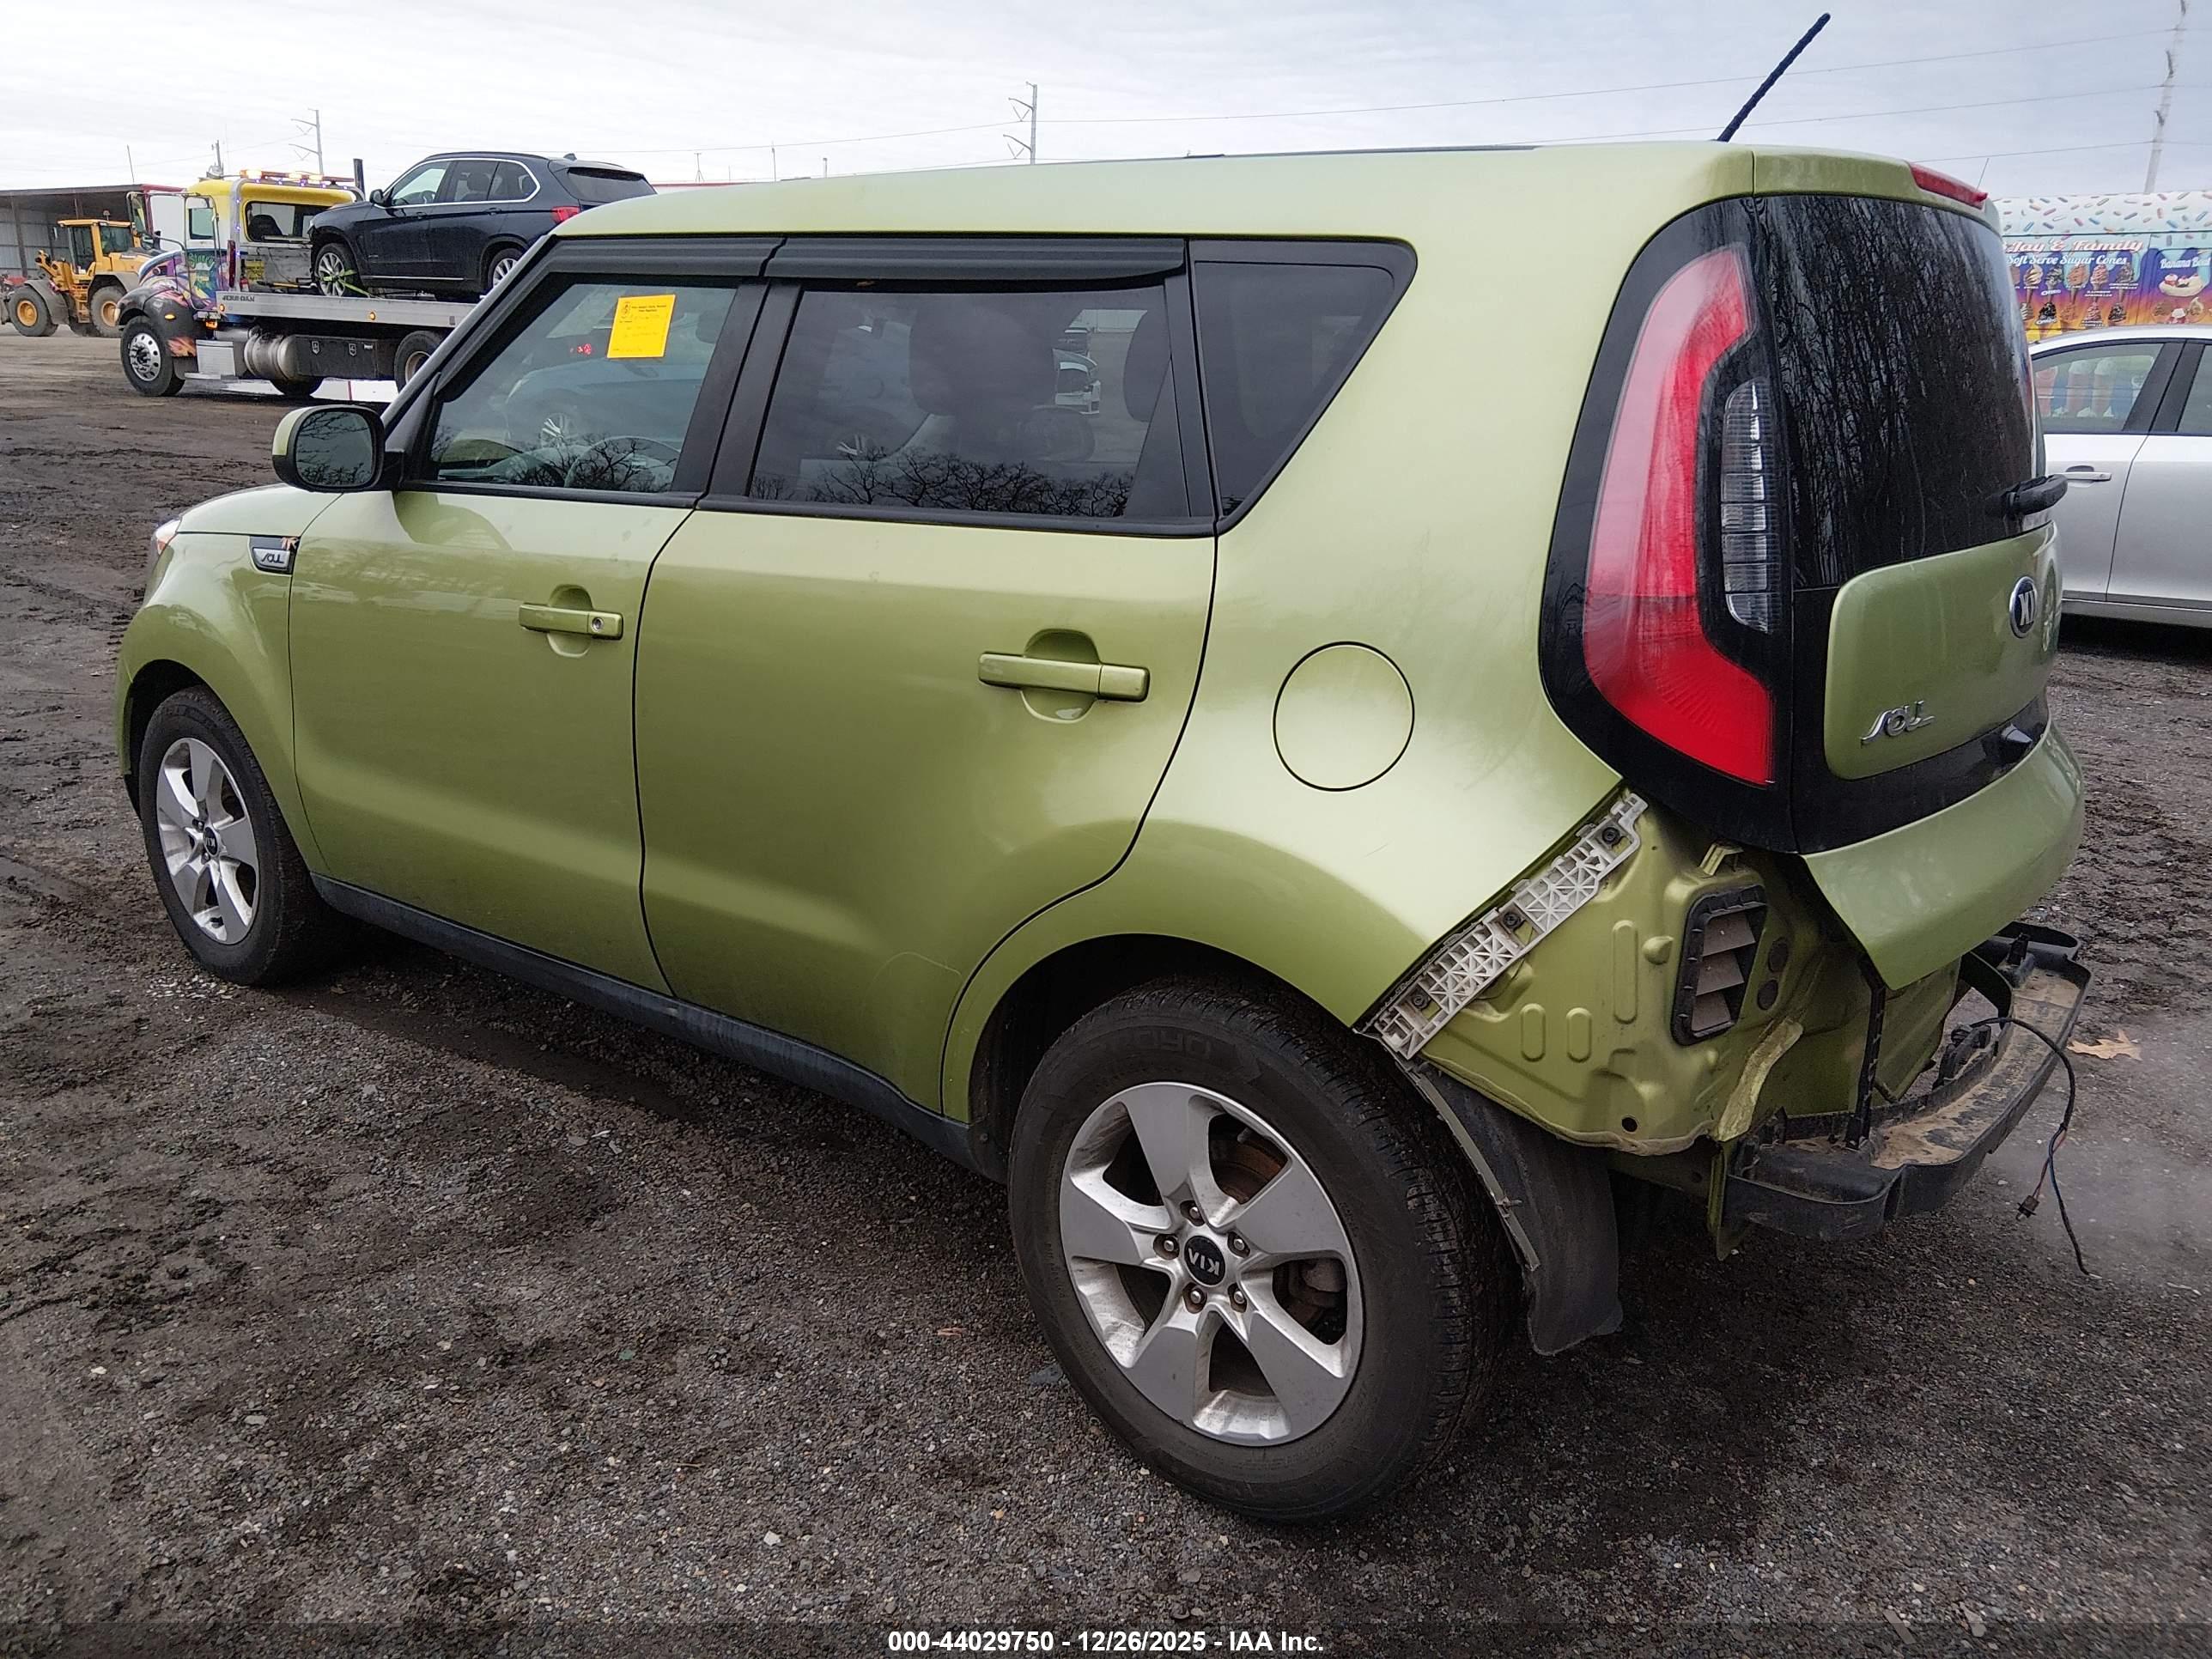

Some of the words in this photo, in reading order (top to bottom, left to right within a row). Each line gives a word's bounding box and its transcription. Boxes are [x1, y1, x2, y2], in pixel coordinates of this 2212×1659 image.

[2072, 239, 2143, 255] Family
[2059, 254, 2094, 267] Sugar
[2095, 254, 2128, 265] Cones
[2160, 258, 2191, 269] Banana
[1188, 1248, 1220, 1276] KIA
